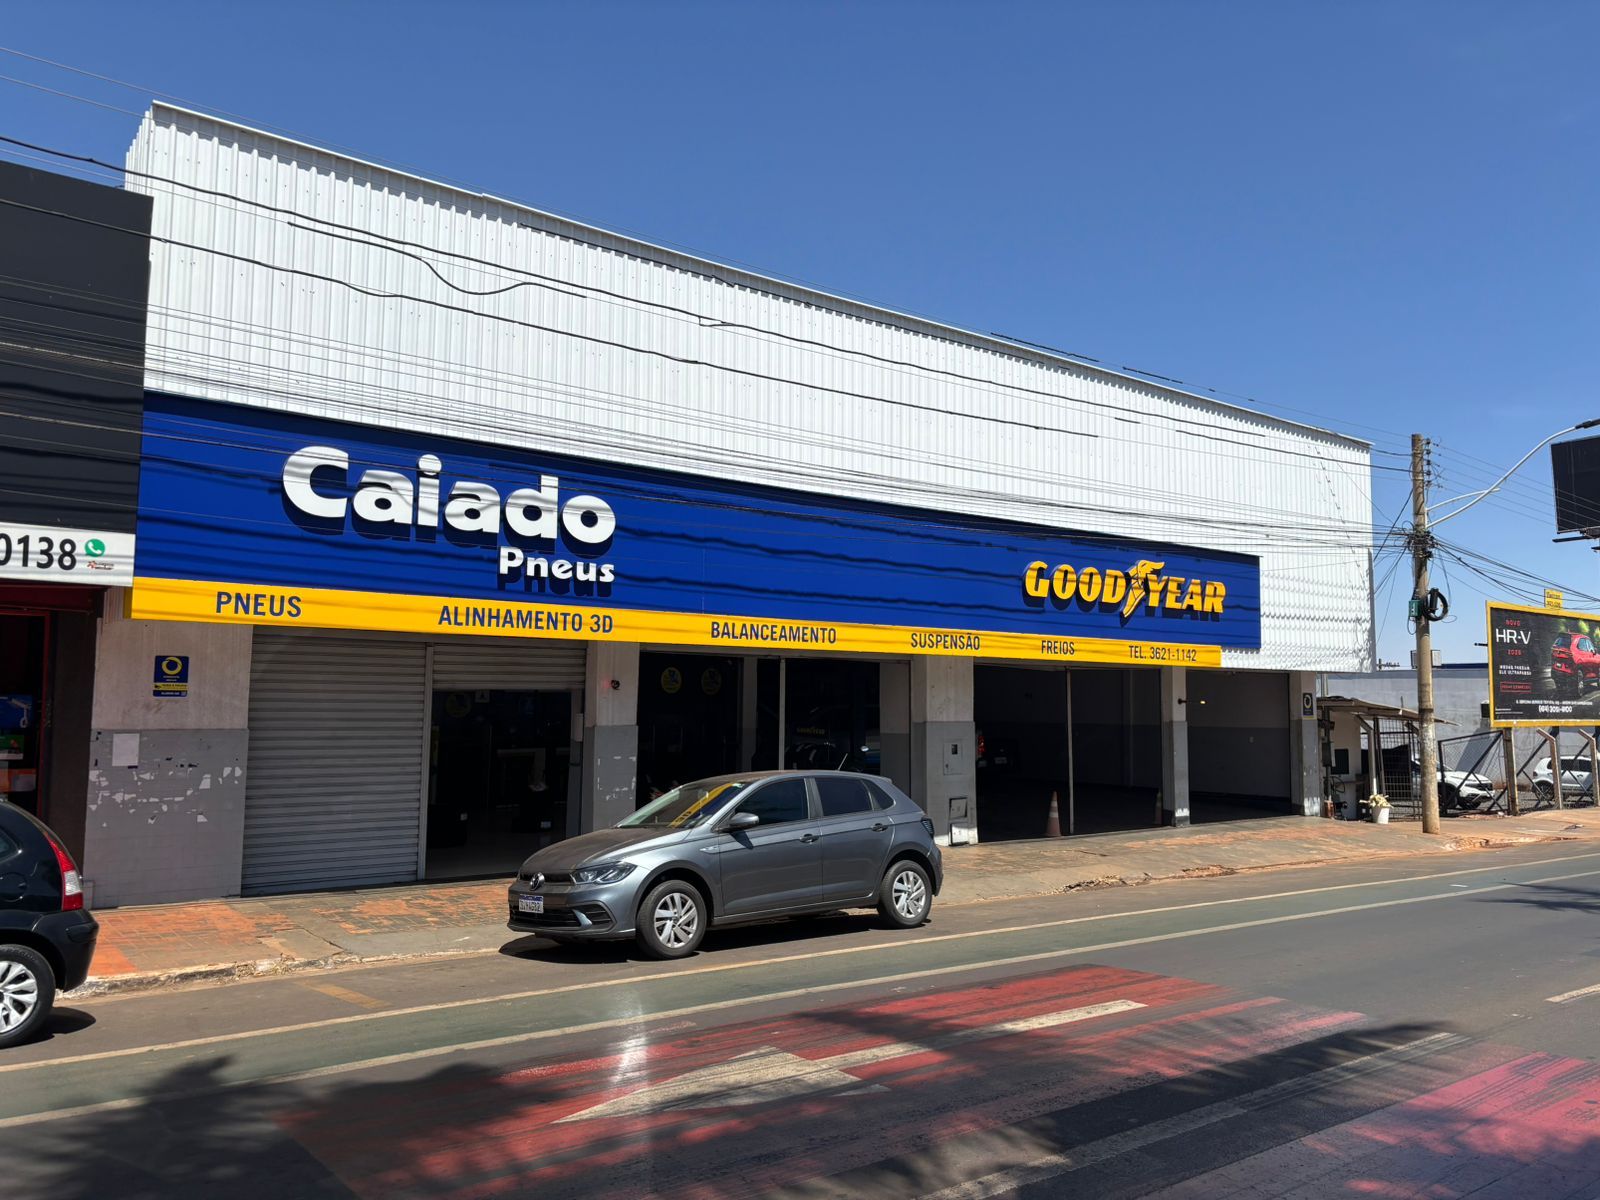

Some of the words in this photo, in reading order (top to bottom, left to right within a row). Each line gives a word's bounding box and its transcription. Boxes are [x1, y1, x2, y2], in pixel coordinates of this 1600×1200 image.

[282, 446, 616, 544] Caiado
[499, 546, 615, 582] Pneus
[1024, 560, 1226, 615] GOODYEAR
[216, 591, 302, 618] PNEUS
[438, 605, 583, 632] ALINHAMENTO
[589, 614, 613, 633] 3D
[711, 621, 837, 644] BALANCEAMENTO
[911, 632, 981, 650] SUSPENSÃO
[1495, 628, 1531, 645] HR-V
[1041, 640, 1075, 655] FREIOS
[1128, 645, 1147, 659] TEL.
[1149, 646, 1197, 662] 3621-1142
